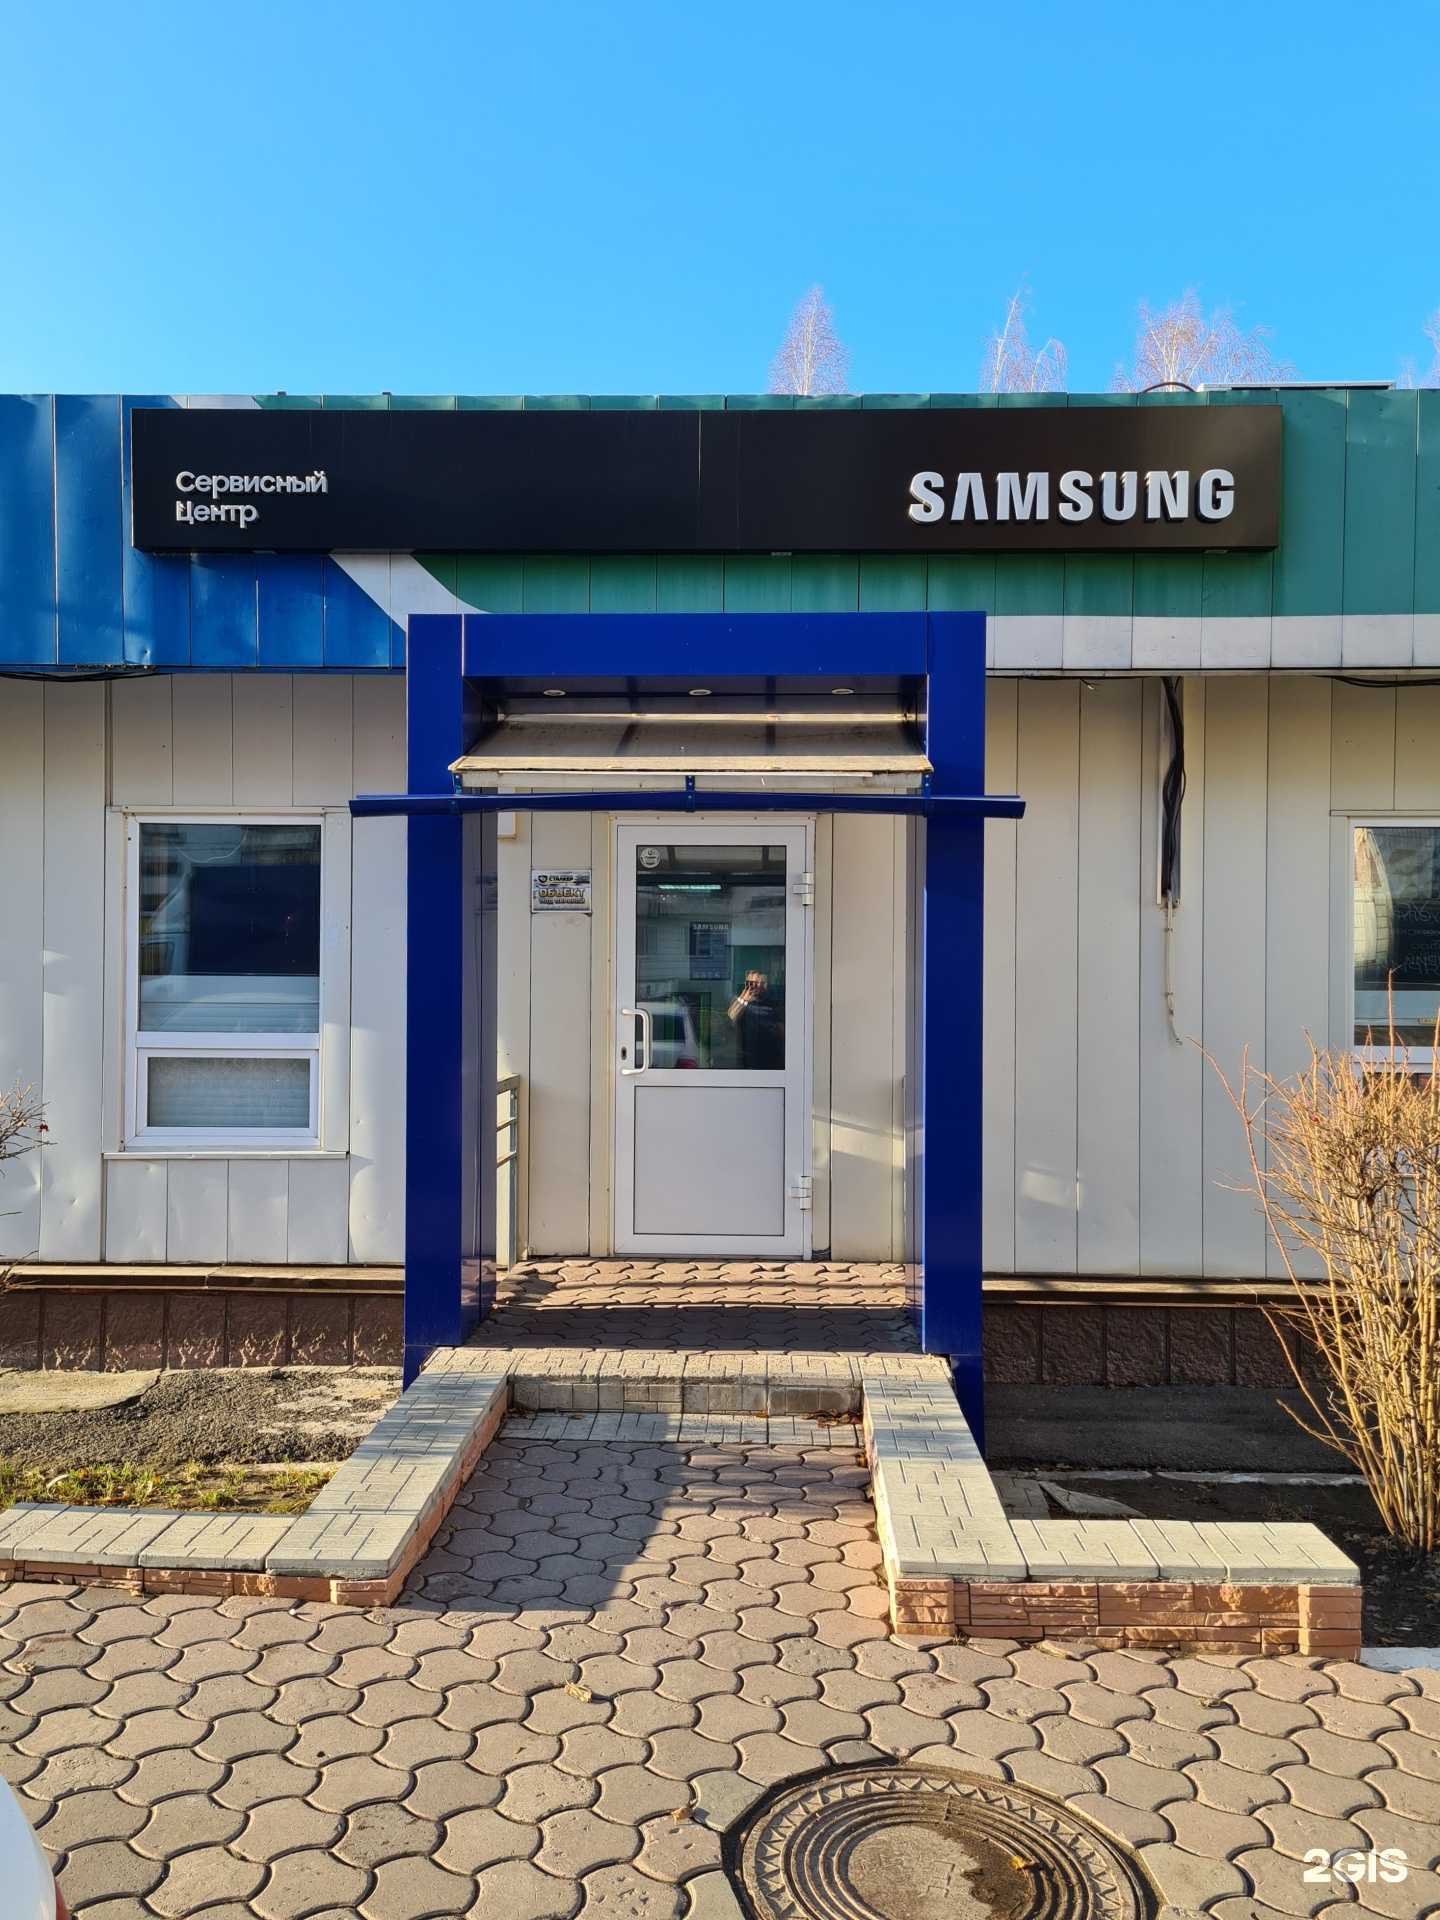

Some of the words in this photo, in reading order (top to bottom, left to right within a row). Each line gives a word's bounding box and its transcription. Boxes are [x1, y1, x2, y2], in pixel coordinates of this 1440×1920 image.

[176, 470, 328, 499] Сервисный
[908, 469, 1236, 523] SAMSUNG
[176, 500, 259, 529] Центр
